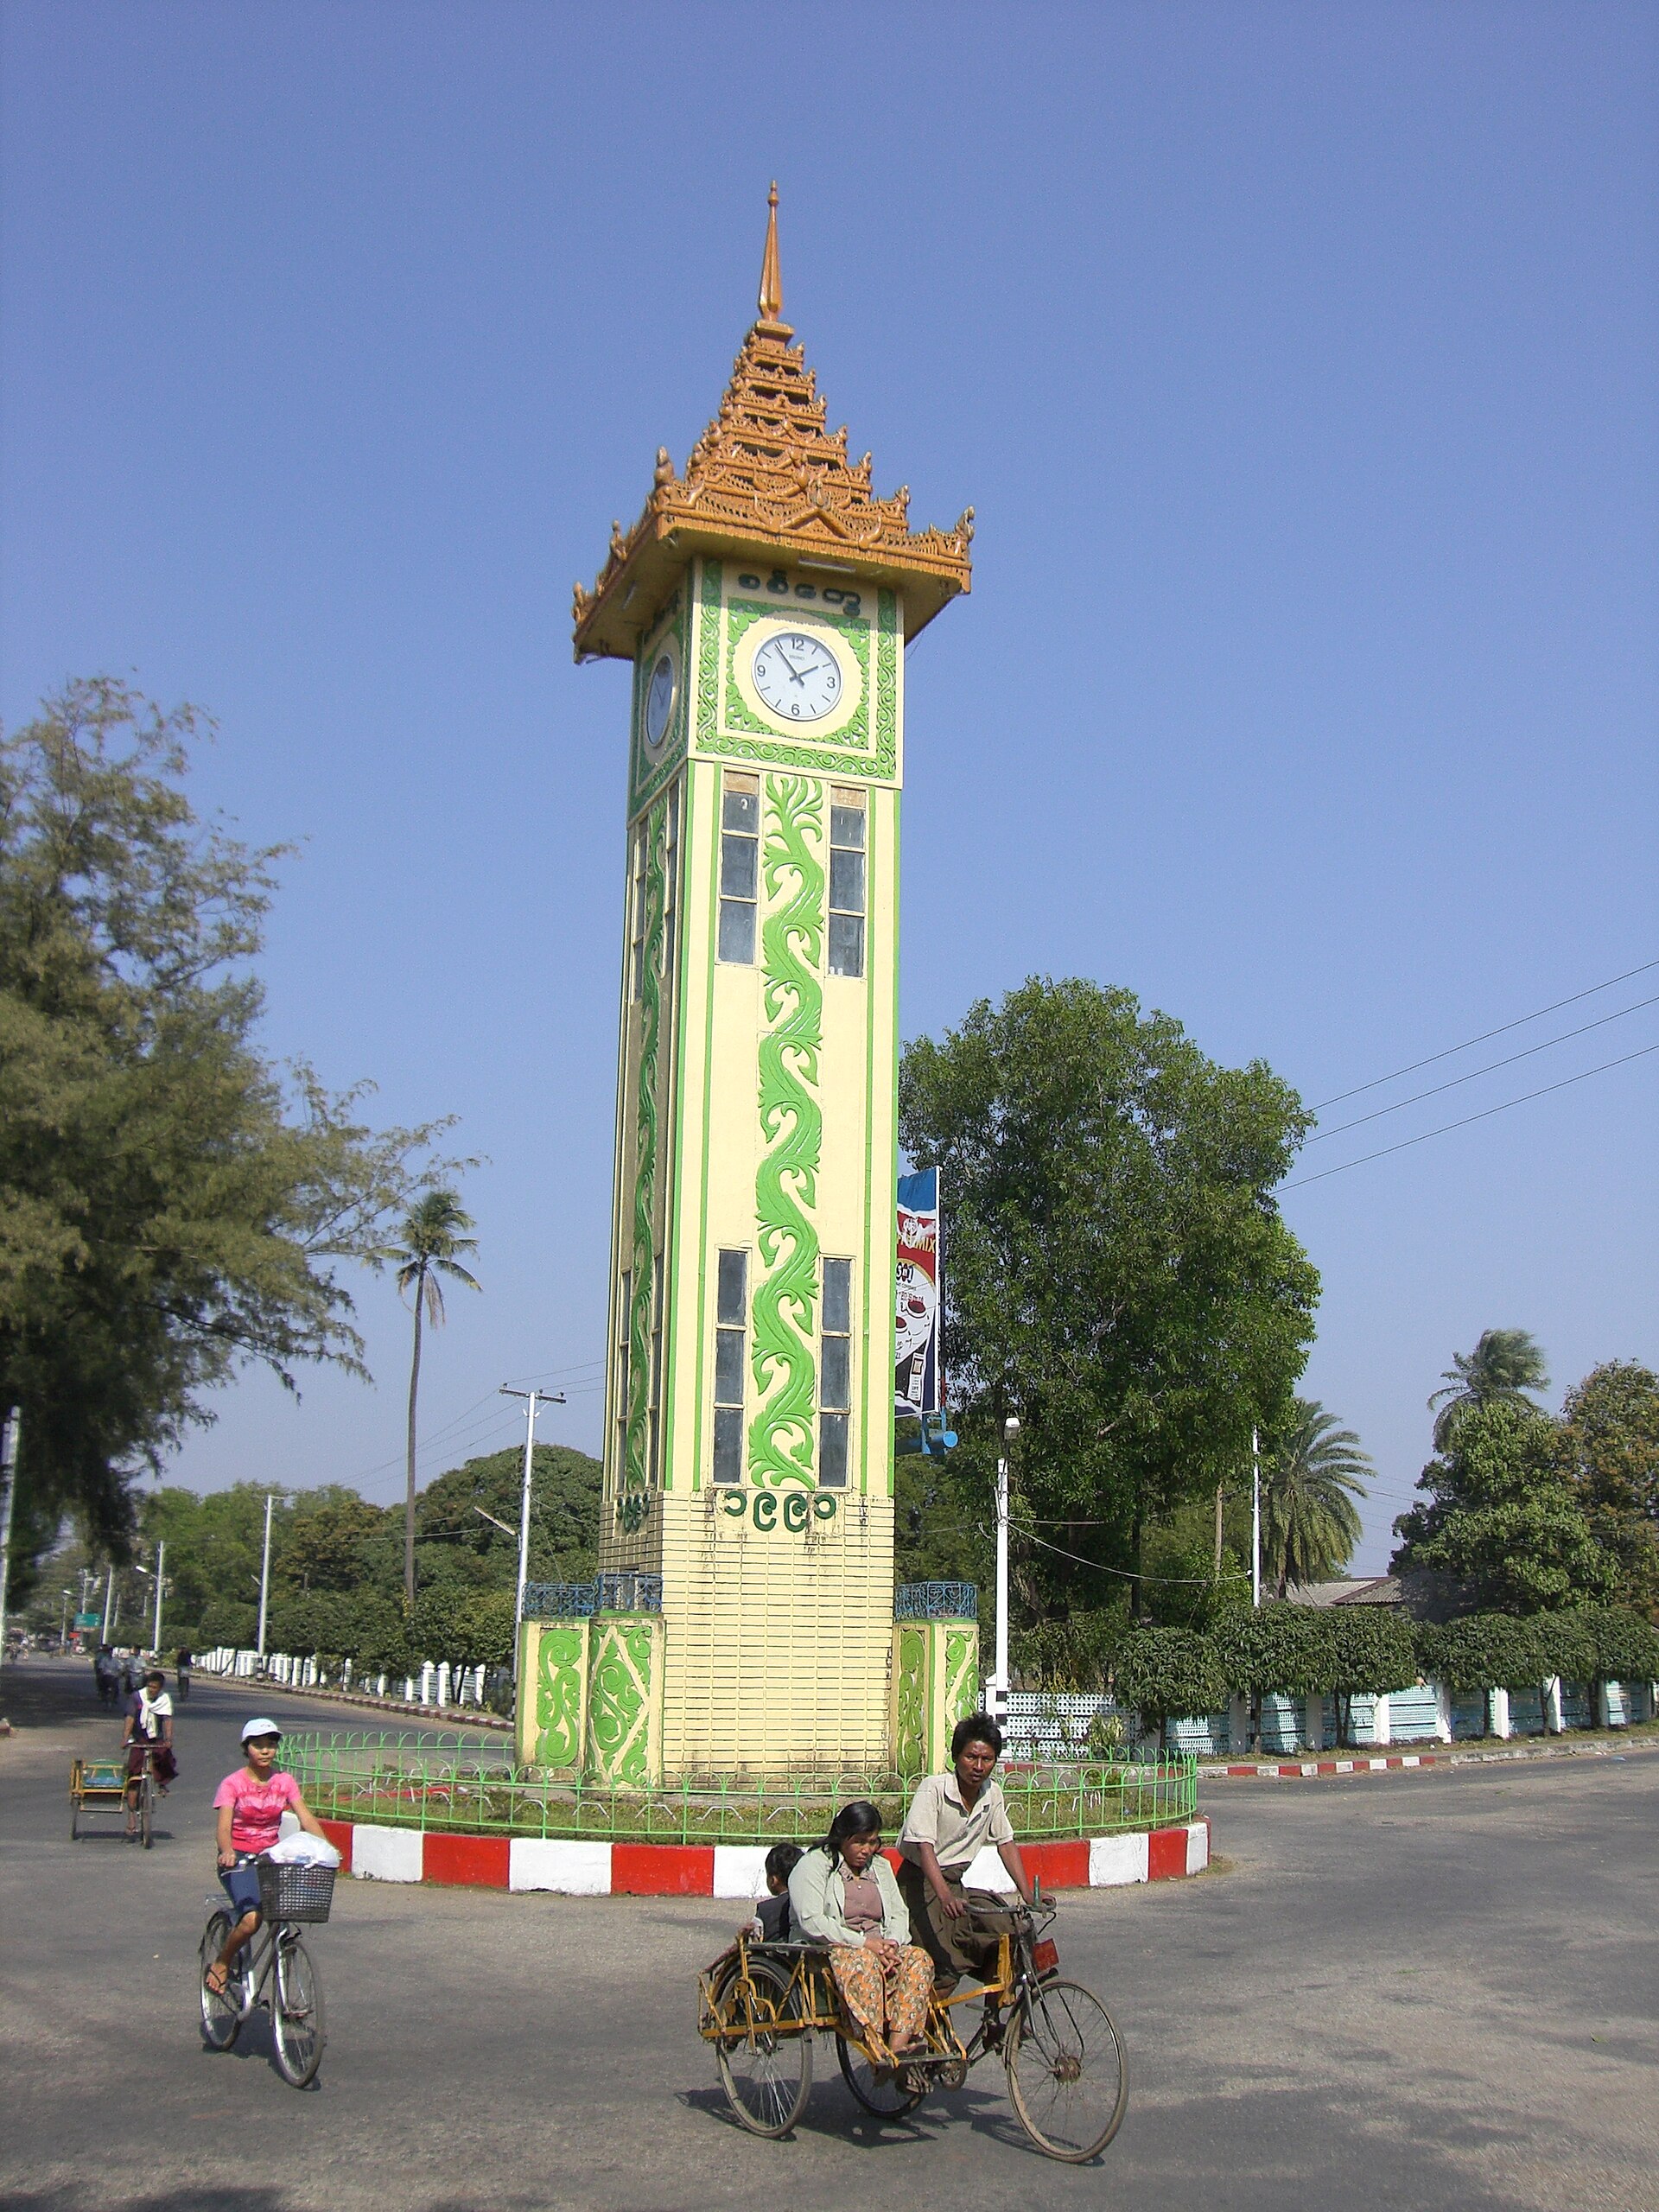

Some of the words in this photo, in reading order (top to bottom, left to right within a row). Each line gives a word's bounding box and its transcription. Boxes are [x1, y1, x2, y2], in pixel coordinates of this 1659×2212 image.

[791, 638, 804, 652] 12
[757, 664, 766, 677] 9
[826, 677, 836, 689] 3
[791, 704, 800, 715] 6
